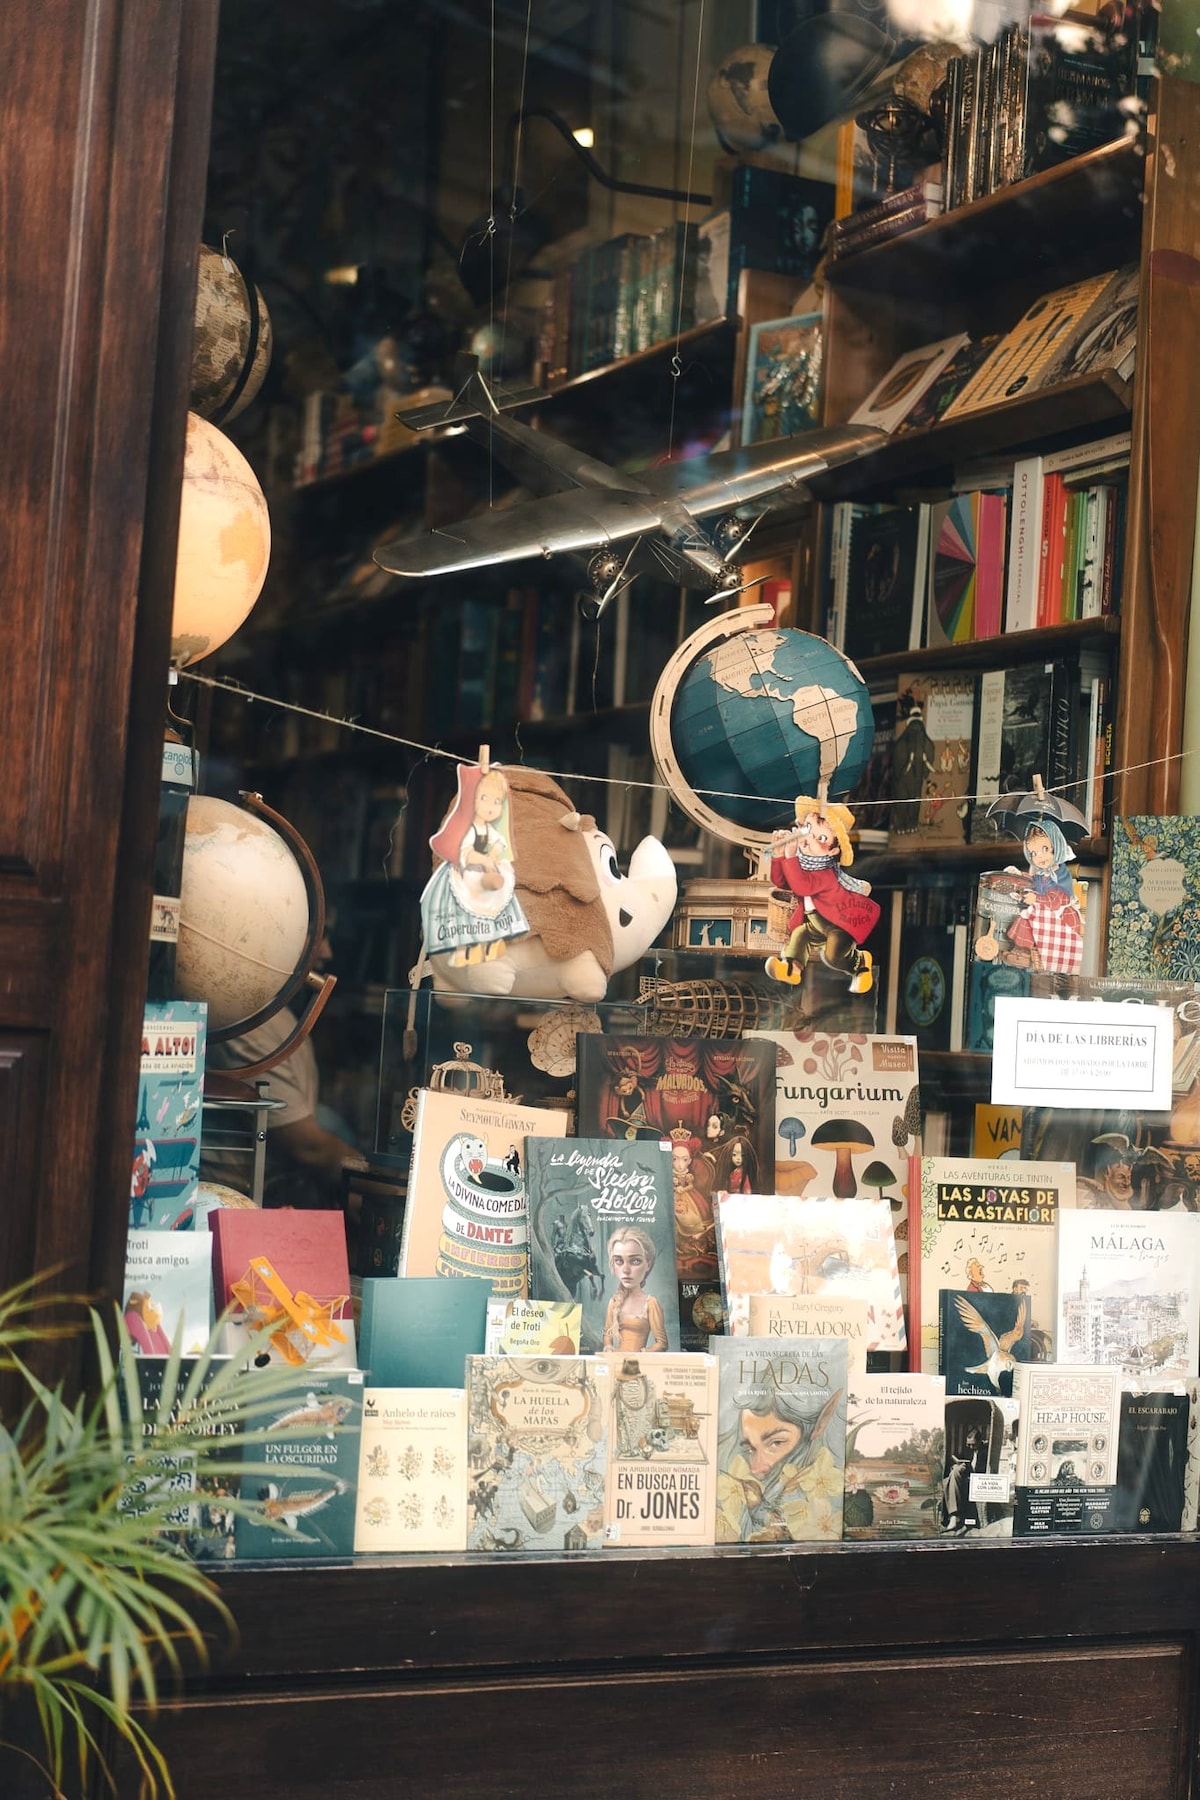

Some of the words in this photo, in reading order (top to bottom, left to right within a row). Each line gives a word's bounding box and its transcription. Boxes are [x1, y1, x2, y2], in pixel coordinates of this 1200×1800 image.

[1017, 473, 1028, 559] OTTOLENGHI
[802, 712, 827, 726] SOUTH
[1105, 724, 1113, 766] BICICLETA
[437, 921, 490, 941] Caperucita
[493, 913, 514, 931] roja
[1026, 1030, 1045, 1044] DÍA
[1048, 1033, 1063, 1044] DE
[1066, 1033, 1087, 1045] LAS
[1089, 1032, 1148, 1047] LIBRERÍAS
[154, 1036, 195, 1057] ALTO!
[880, 1043, 906, 1054] Visita
[878, 1060, 907, 1069] Museo
[1127, 1060, 1149, 1069] TARDE
[588, 1167, 657, 1195] Sleepy
[943, 1171, 959, 1180] LAS
[961, 1171, 1011, 1183] AVENTURAS
[1013, 1174, 1024, 1183] DE
[1026, 1174, 1054, 1184] TINTÍN
[448, 1177, 455, 1189] LA
[455, 1184, 486, 1211] DIVINA
[591, 1187, 658, 1214] Hollow
[941, 1186, 971, 1202] LAS
[977, 1187, 1030, 1204] JOYAS
[1036, 1190, 1055, 1206] DE
[938, 1204, 959, 1219] LA
[455, 1222, 466, 1236] DE
[466, 1222, 514, 1245] DANTE
[127, 1239, 149, 1250] Troti
[1091, 1232, 1165, 1251] MÁLAGA
[445, 1241, 522, 1268] INFIERNO
[125, 1254, 153, 1265] busca
[155, 1254, 190, 1269] amigos
[511, 1307, 519, 1317] El
[521, 1307, 544, 1318] deseo
[769, 1309, 782, 1319] LA
[814, 1303, 845, 1314] Gregory
[510, 1320, 521, 1330] de
[523, 1321, 541, 1331] Troti
[768, 1319, 863, 1339] REVELADORA
[739, 1359, 829, 1391] HADAS
[880, 1386, 888, 1394] El
[889, 1386, 913, 1395] tejido
[957, 1383, 992, 1396] hechizos
[514, 1396, 527, 1405] LA
[530, 1396, 570, 1406] HUELLA
[865, 1397, 875, 1405] de
[876, 1397, 884, 1405] la
[884, 1397, 927, 1405] naturaleza
[382, 1407, 415, 1418] Anhelo
[417, 1408, 429, 1418] de
[430, 1408, 457, 1418] raíces
[528, 1406, 539, 1415] de
[541, 1406, 555, 1416] los
[1127, 1406, 1137, 1414] EL
[1137, 1406, 1178, 1415] ESCARABAJO
[523, 1416, 559, 1425] MAPAS
[1036, 1412, 1068, 1424] HEAP
[1070, 1412, 1107, 1424] HOUSE
[265, 1445, 282, 1454] UN
[283, 1445, 323, 1455] FULGOR
[324, 1445, 338, 1455] EN
[265, 1455, 279, 1464] LA
[280, 1455, 338, 1464] OSCURIDAD
[617, 1474, 633, 1490] EN
[636, 1474, 677, 1490] BUSCA
[680, 1474, 701, 1491] DEL
[616, 1499, 635, 1519] Dr.
[640, 1492, 700, 1520] JONES
